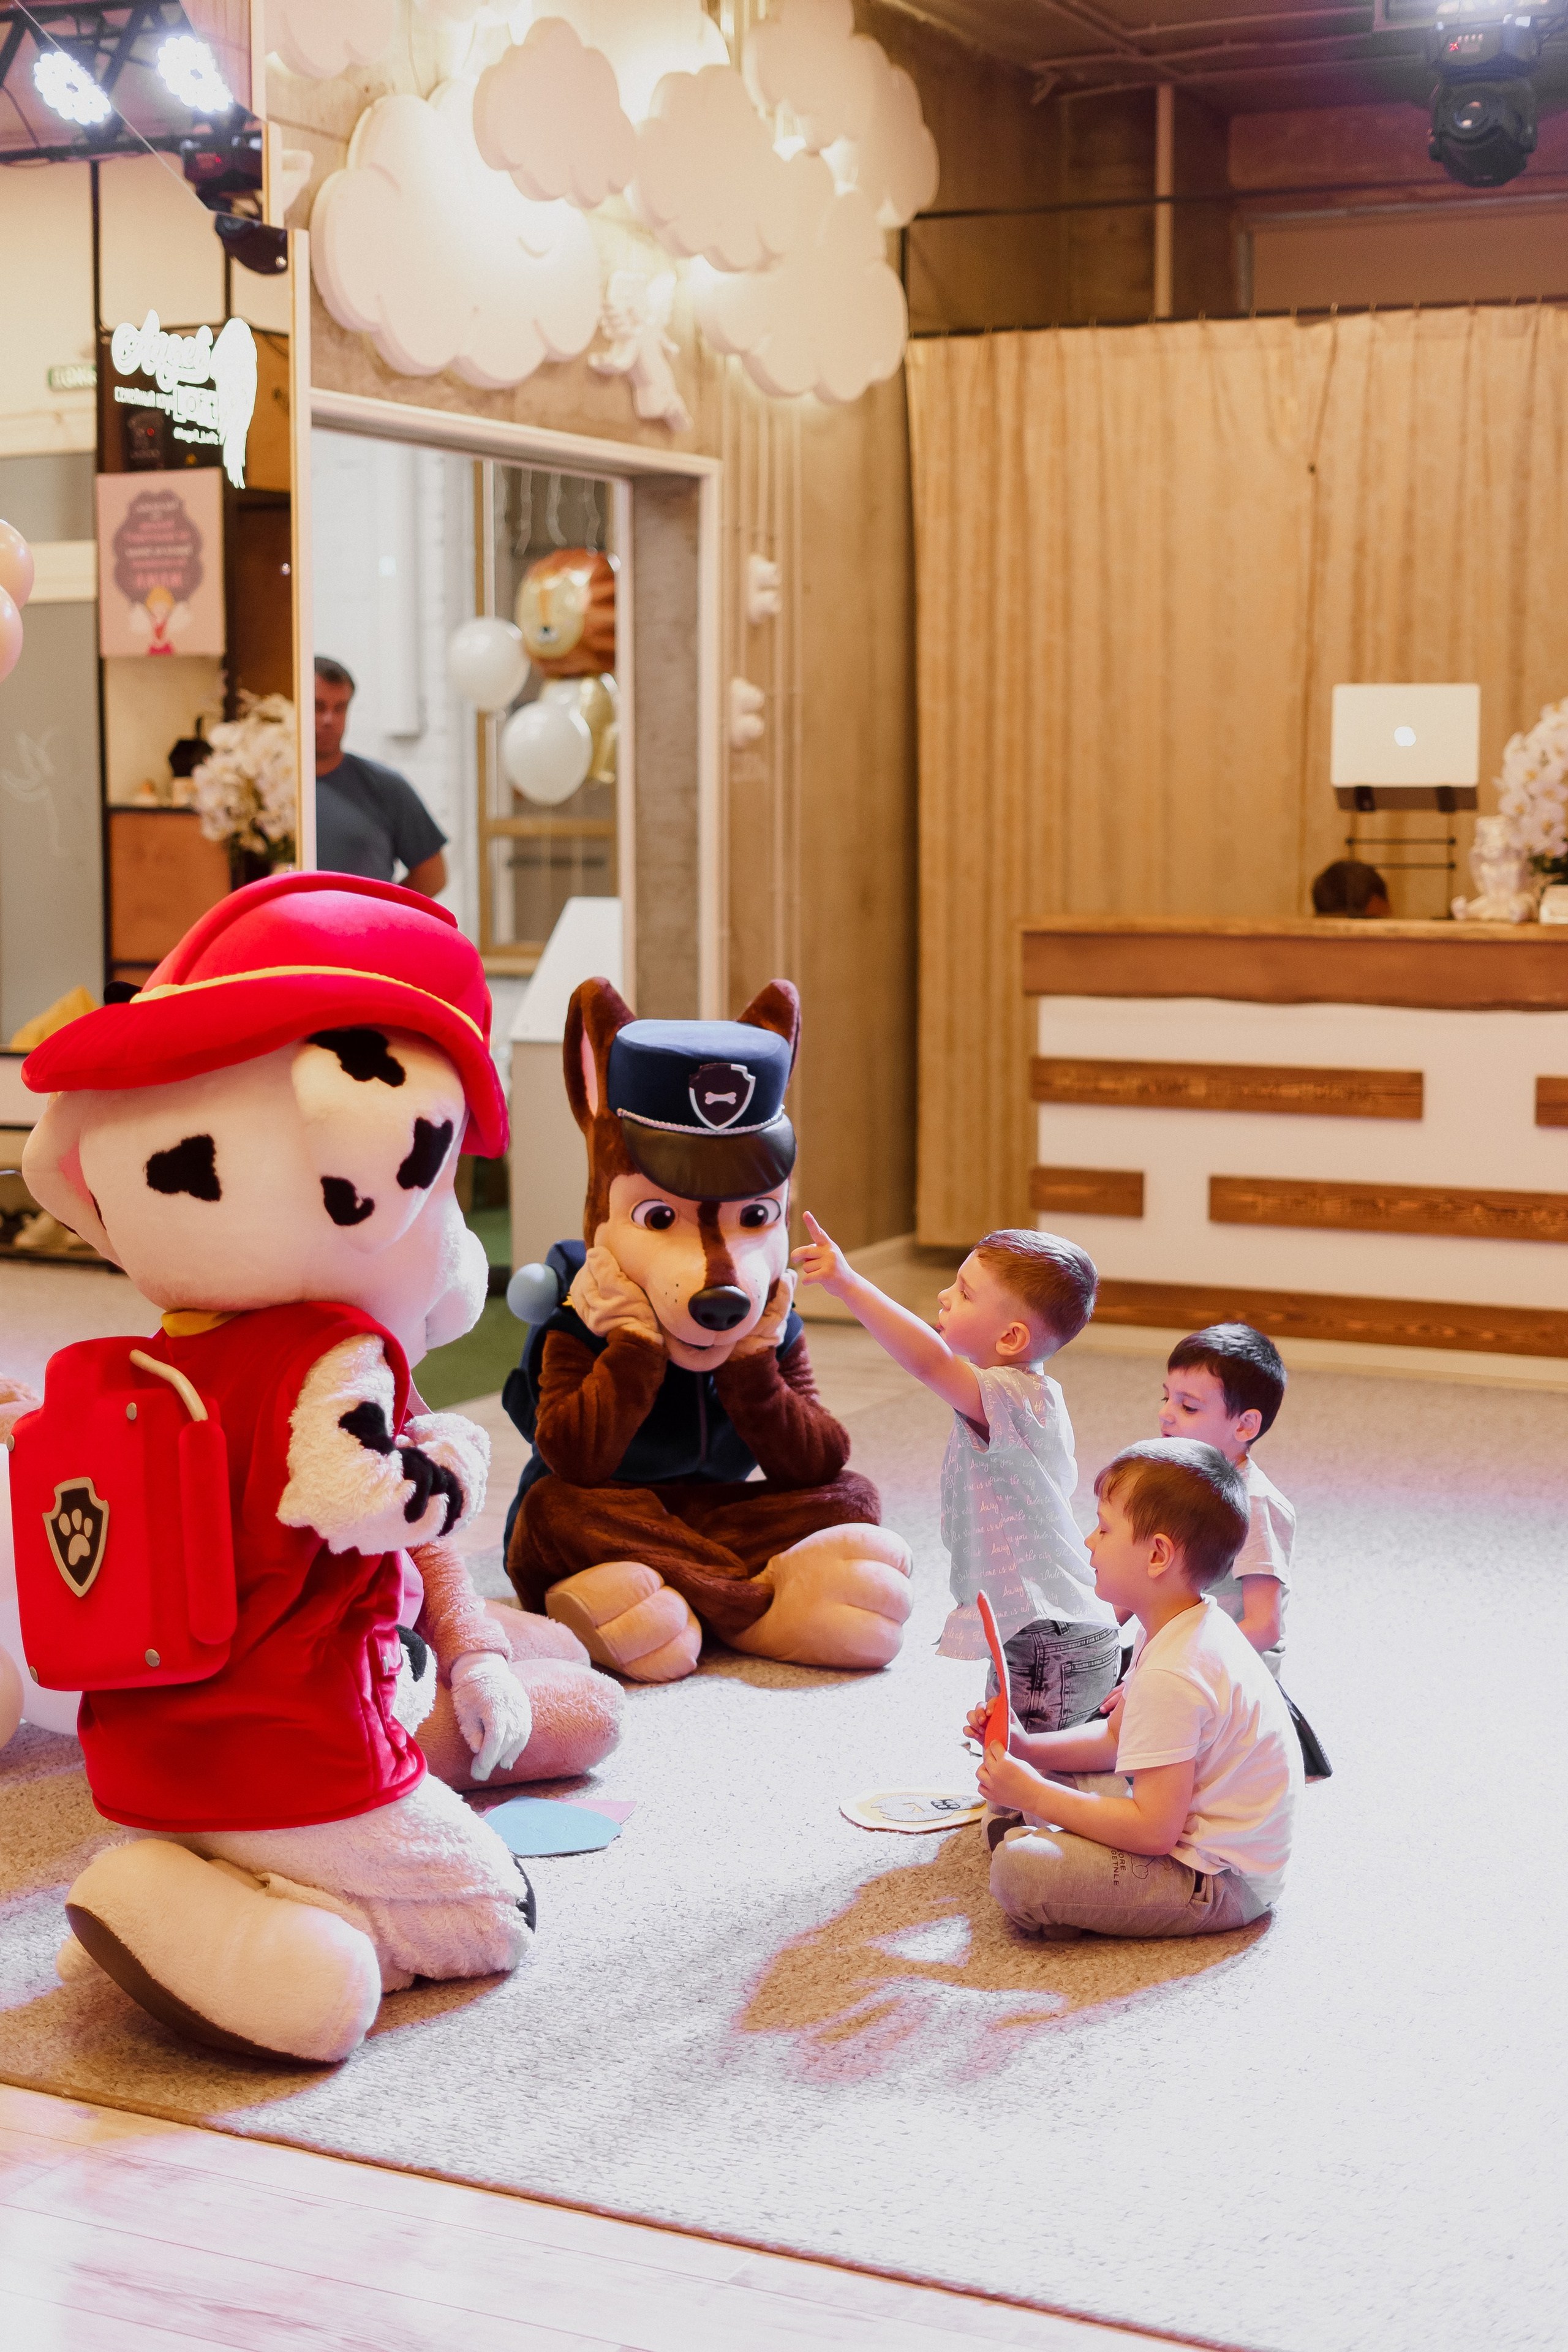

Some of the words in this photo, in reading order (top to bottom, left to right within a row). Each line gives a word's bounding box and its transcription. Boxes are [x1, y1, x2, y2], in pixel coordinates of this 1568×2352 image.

[970, 1458, 989, 1472] Away
[1000, 1459, 1014, 1468] you
[1010, 1474, 1019, 1485] the
[1022, 1476, 1035, 1490] city
[1005, 1494, 1017, 1506] you
[979, 1500, 998, 1514] Away
[1016, 1509, 1025, 1520] the
[1015, 1534, 1028, 1547] you
[990, 1543, 1011, 1556] Away
[1025, 1549, 1036, 1562] the
[1039, 1550, 1052, 1564] city
[1041, 1569, 1064, 1581] Under
[1001, 1585, 1023, 1598] Away
[1117, 1849, 1126, 1871] ORE
